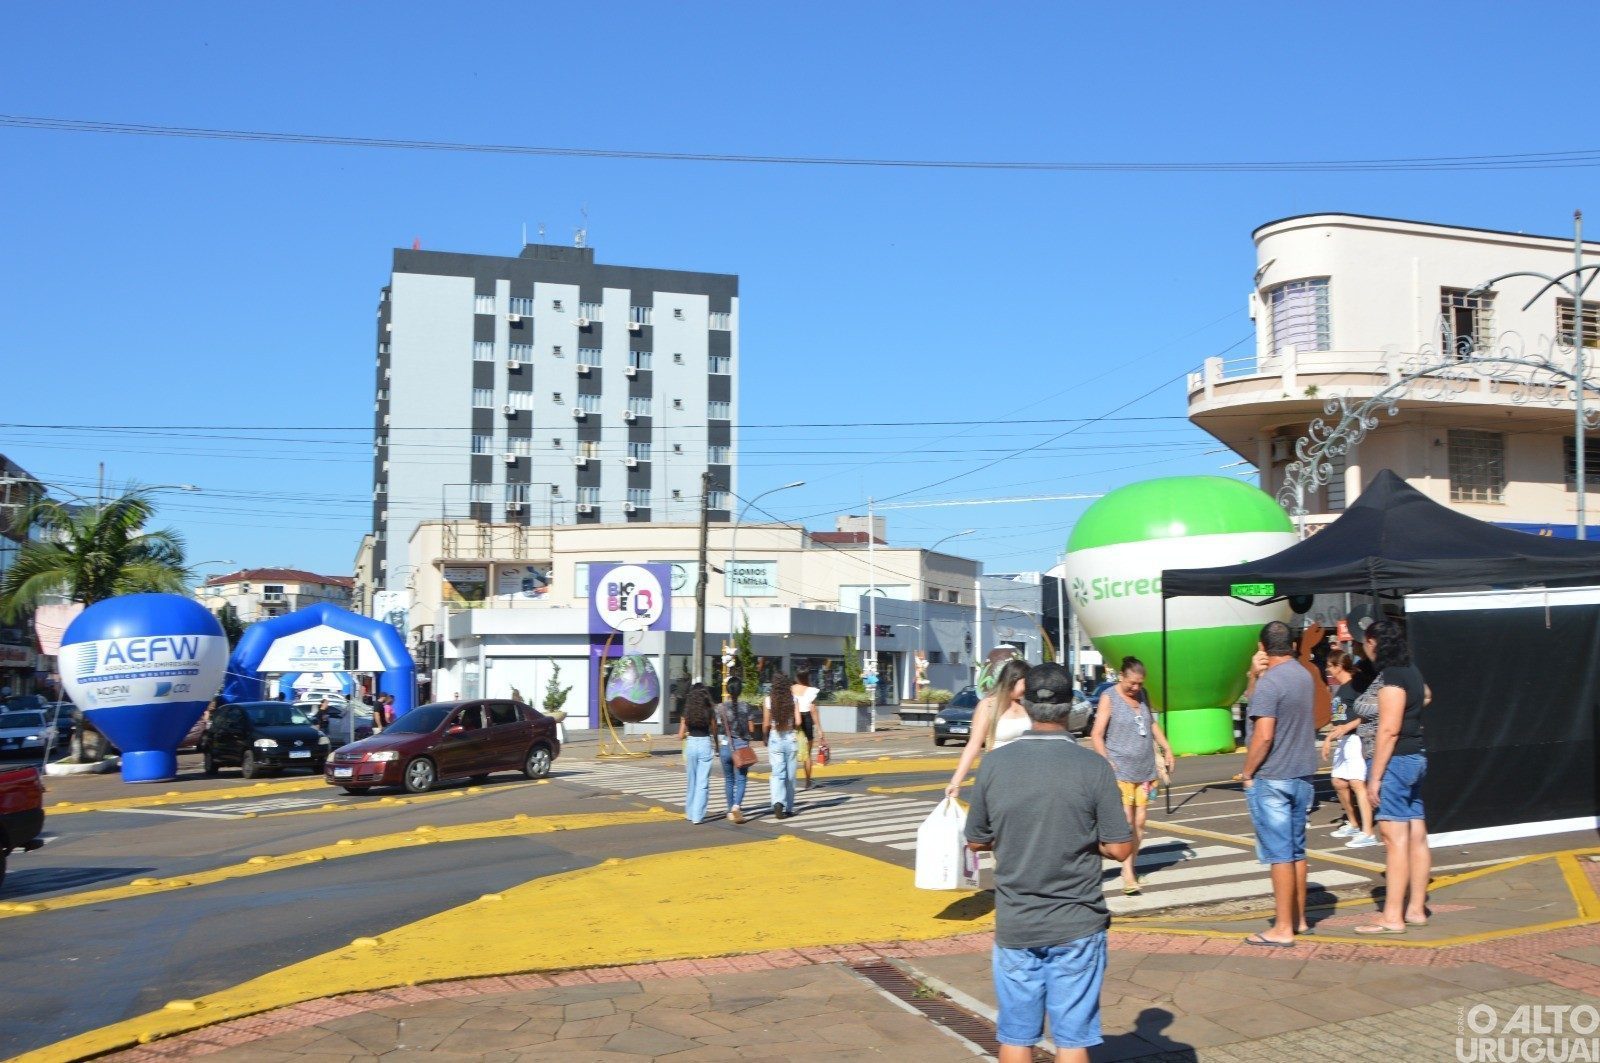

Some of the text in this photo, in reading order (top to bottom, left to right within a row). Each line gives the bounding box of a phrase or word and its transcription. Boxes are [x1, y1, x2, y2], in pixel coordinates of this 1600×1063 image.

[733, 568, 767, 576] SOMOS
[607, 582, 635, 596] BIG
[105, 637, 199, 665] AEFW
